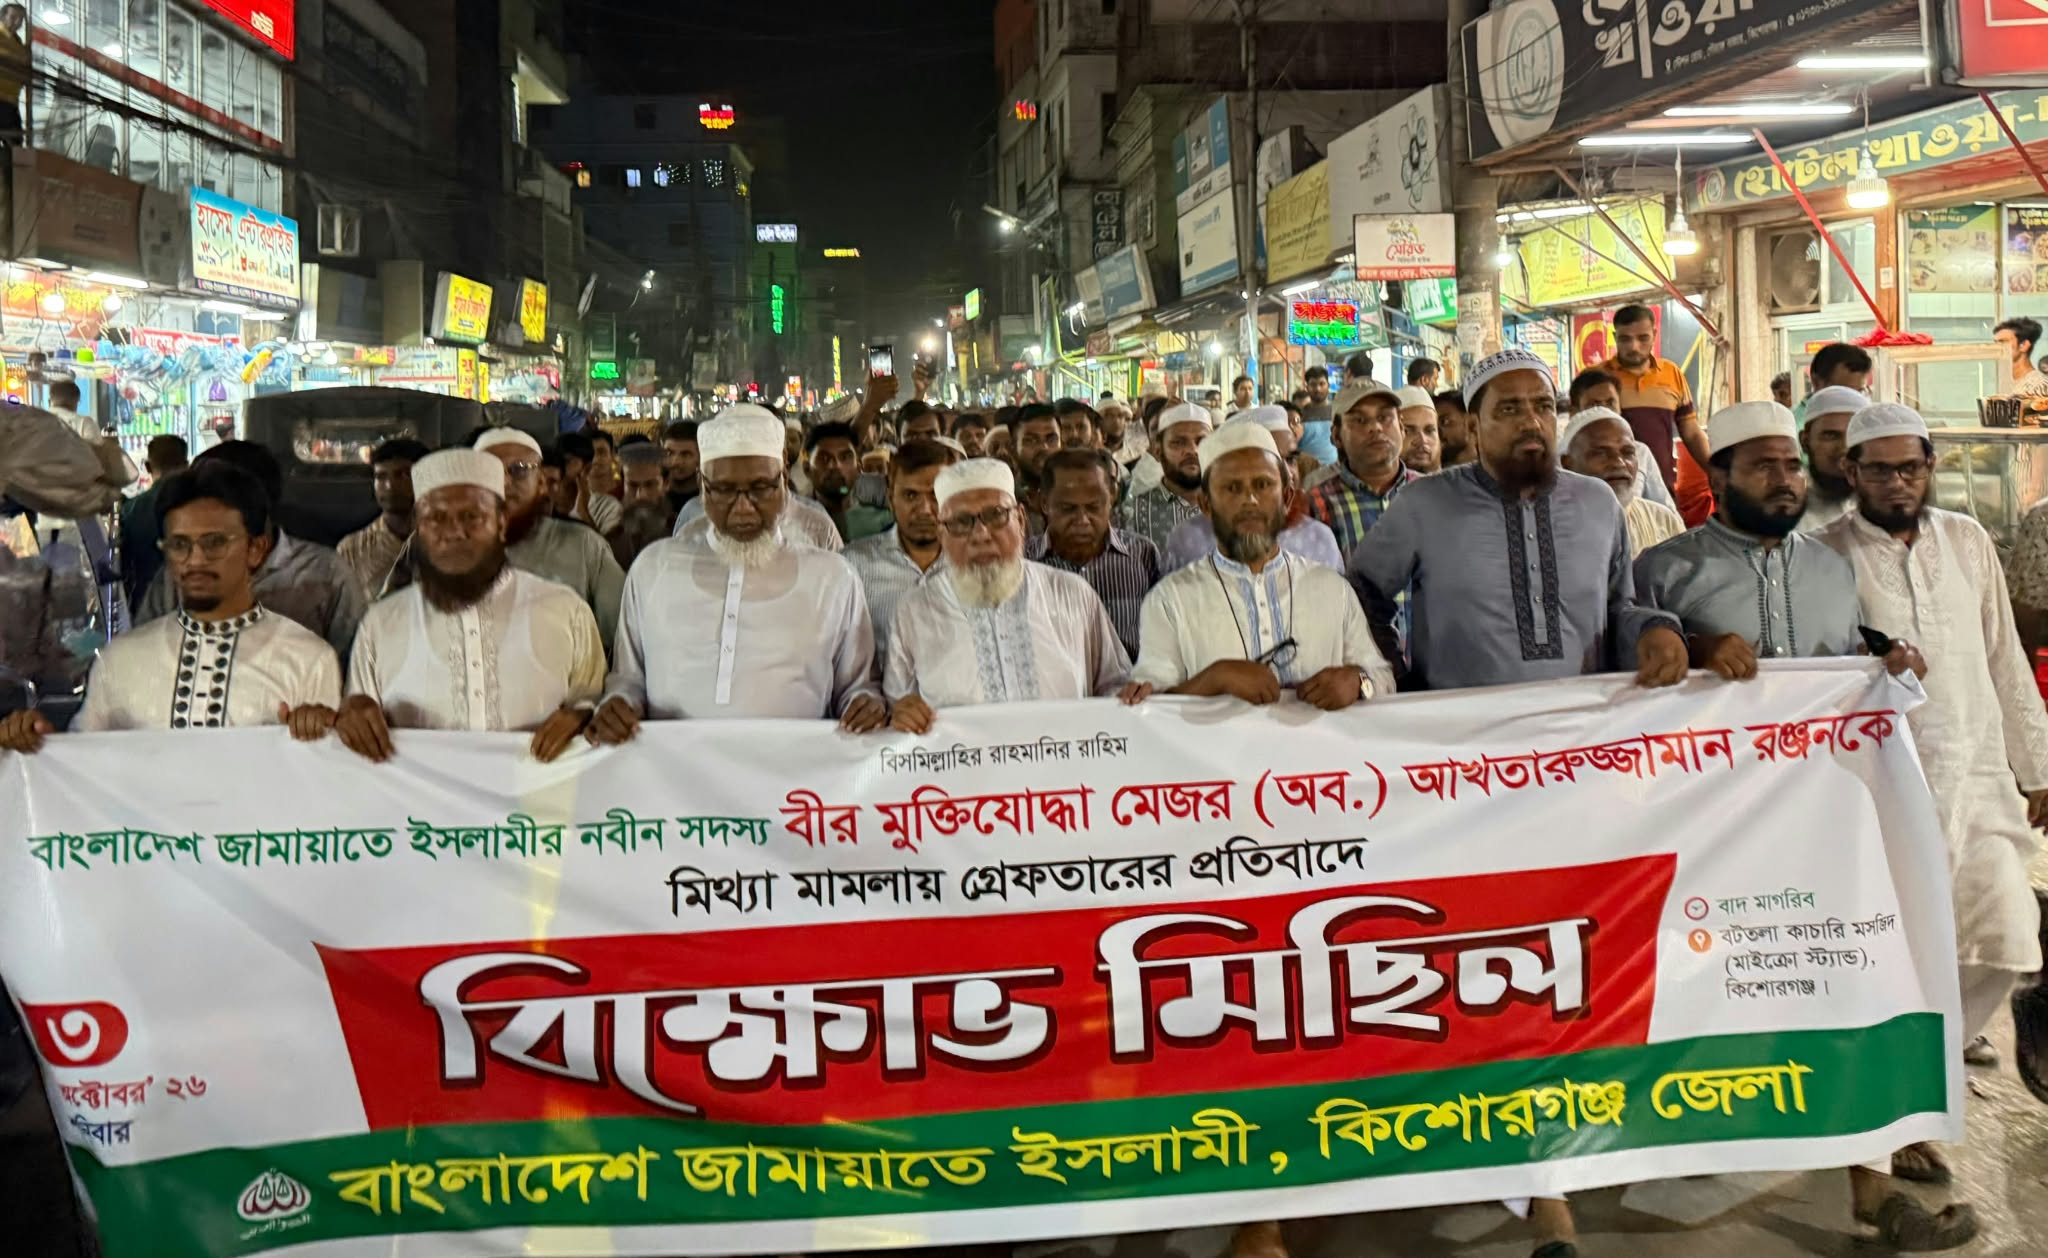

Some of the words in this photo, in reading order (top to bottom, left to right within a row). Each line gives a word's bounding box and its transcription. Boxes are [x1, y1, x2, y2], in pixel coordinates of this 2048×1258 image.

[1734, 146, 1861, 201] হোটেল
[196, 203, 233, 243] হাসেম
[238, 211, 294, 259] এন্টারপ্রাইজ
[881, 743, 982, 774] বিসমিল্লাহির
[988, 736, 1071, 764] রাহমানির
[1076, 732, 1128, 758] রাহিম
[27, 827, 204, 870] বাংলাদেশ
[214, 827, 397, 867] জামায়াতে
[406, 813, 566, 861] ইসলামীর
[576, 808, 667, 855] নবীন
[676, 816, 772, 848] সদস্য
[779, 789, 862, 848] বীর
[874, 784, 1095, 854] মুক্তিযোদ্ধা
[1112, 780, 1237, 826] মেজর
[1254, 761, 1387, 829] (অব.)
[1402, 727, 1734, 800] আখতারুজ্জামান
[1744, 709, 1897, 763] রঞ্জনকে
[664, 865, 780, 918] মিথ্যা
[789, 865, 947, 907] মামলায়
[962, 854, 1176, 901] গ্রেফতারের
[1189, 835, 1368, 887] প্রতিবাদে
[1718, 897, 1748, 915] বাদ
[1754, 888, 1814, 910] মাগরিব
[1719, 924, 1779, 945] বটতলা
[1784, 917, 1845, 940] কাচারি
[1851, 913, 1895, 937] মসজিদ
[1725, 950, 1799, 976] (মাইক্রো
[1804, 947, 1875, 970] স্ট্যান্ড),
[421, 954, 1054, 1108] বিক্ষোভ
[1096, 893, 1588, 1052] মিছিল
[47, 1011, 100, 1060] ৩
[166, 1076, 206, 1100] ২৬
[70, 1114, 134, 1146] নিবার
[331, 1146, 658, 1212] বাংলাদেশ
[675, 1144, 992, 1195] জামায়াতে
[1308, 1076, 1627, 1160] কিশোরগঞ্জ
[1651, 1060, 1813, 1119] জেলা
